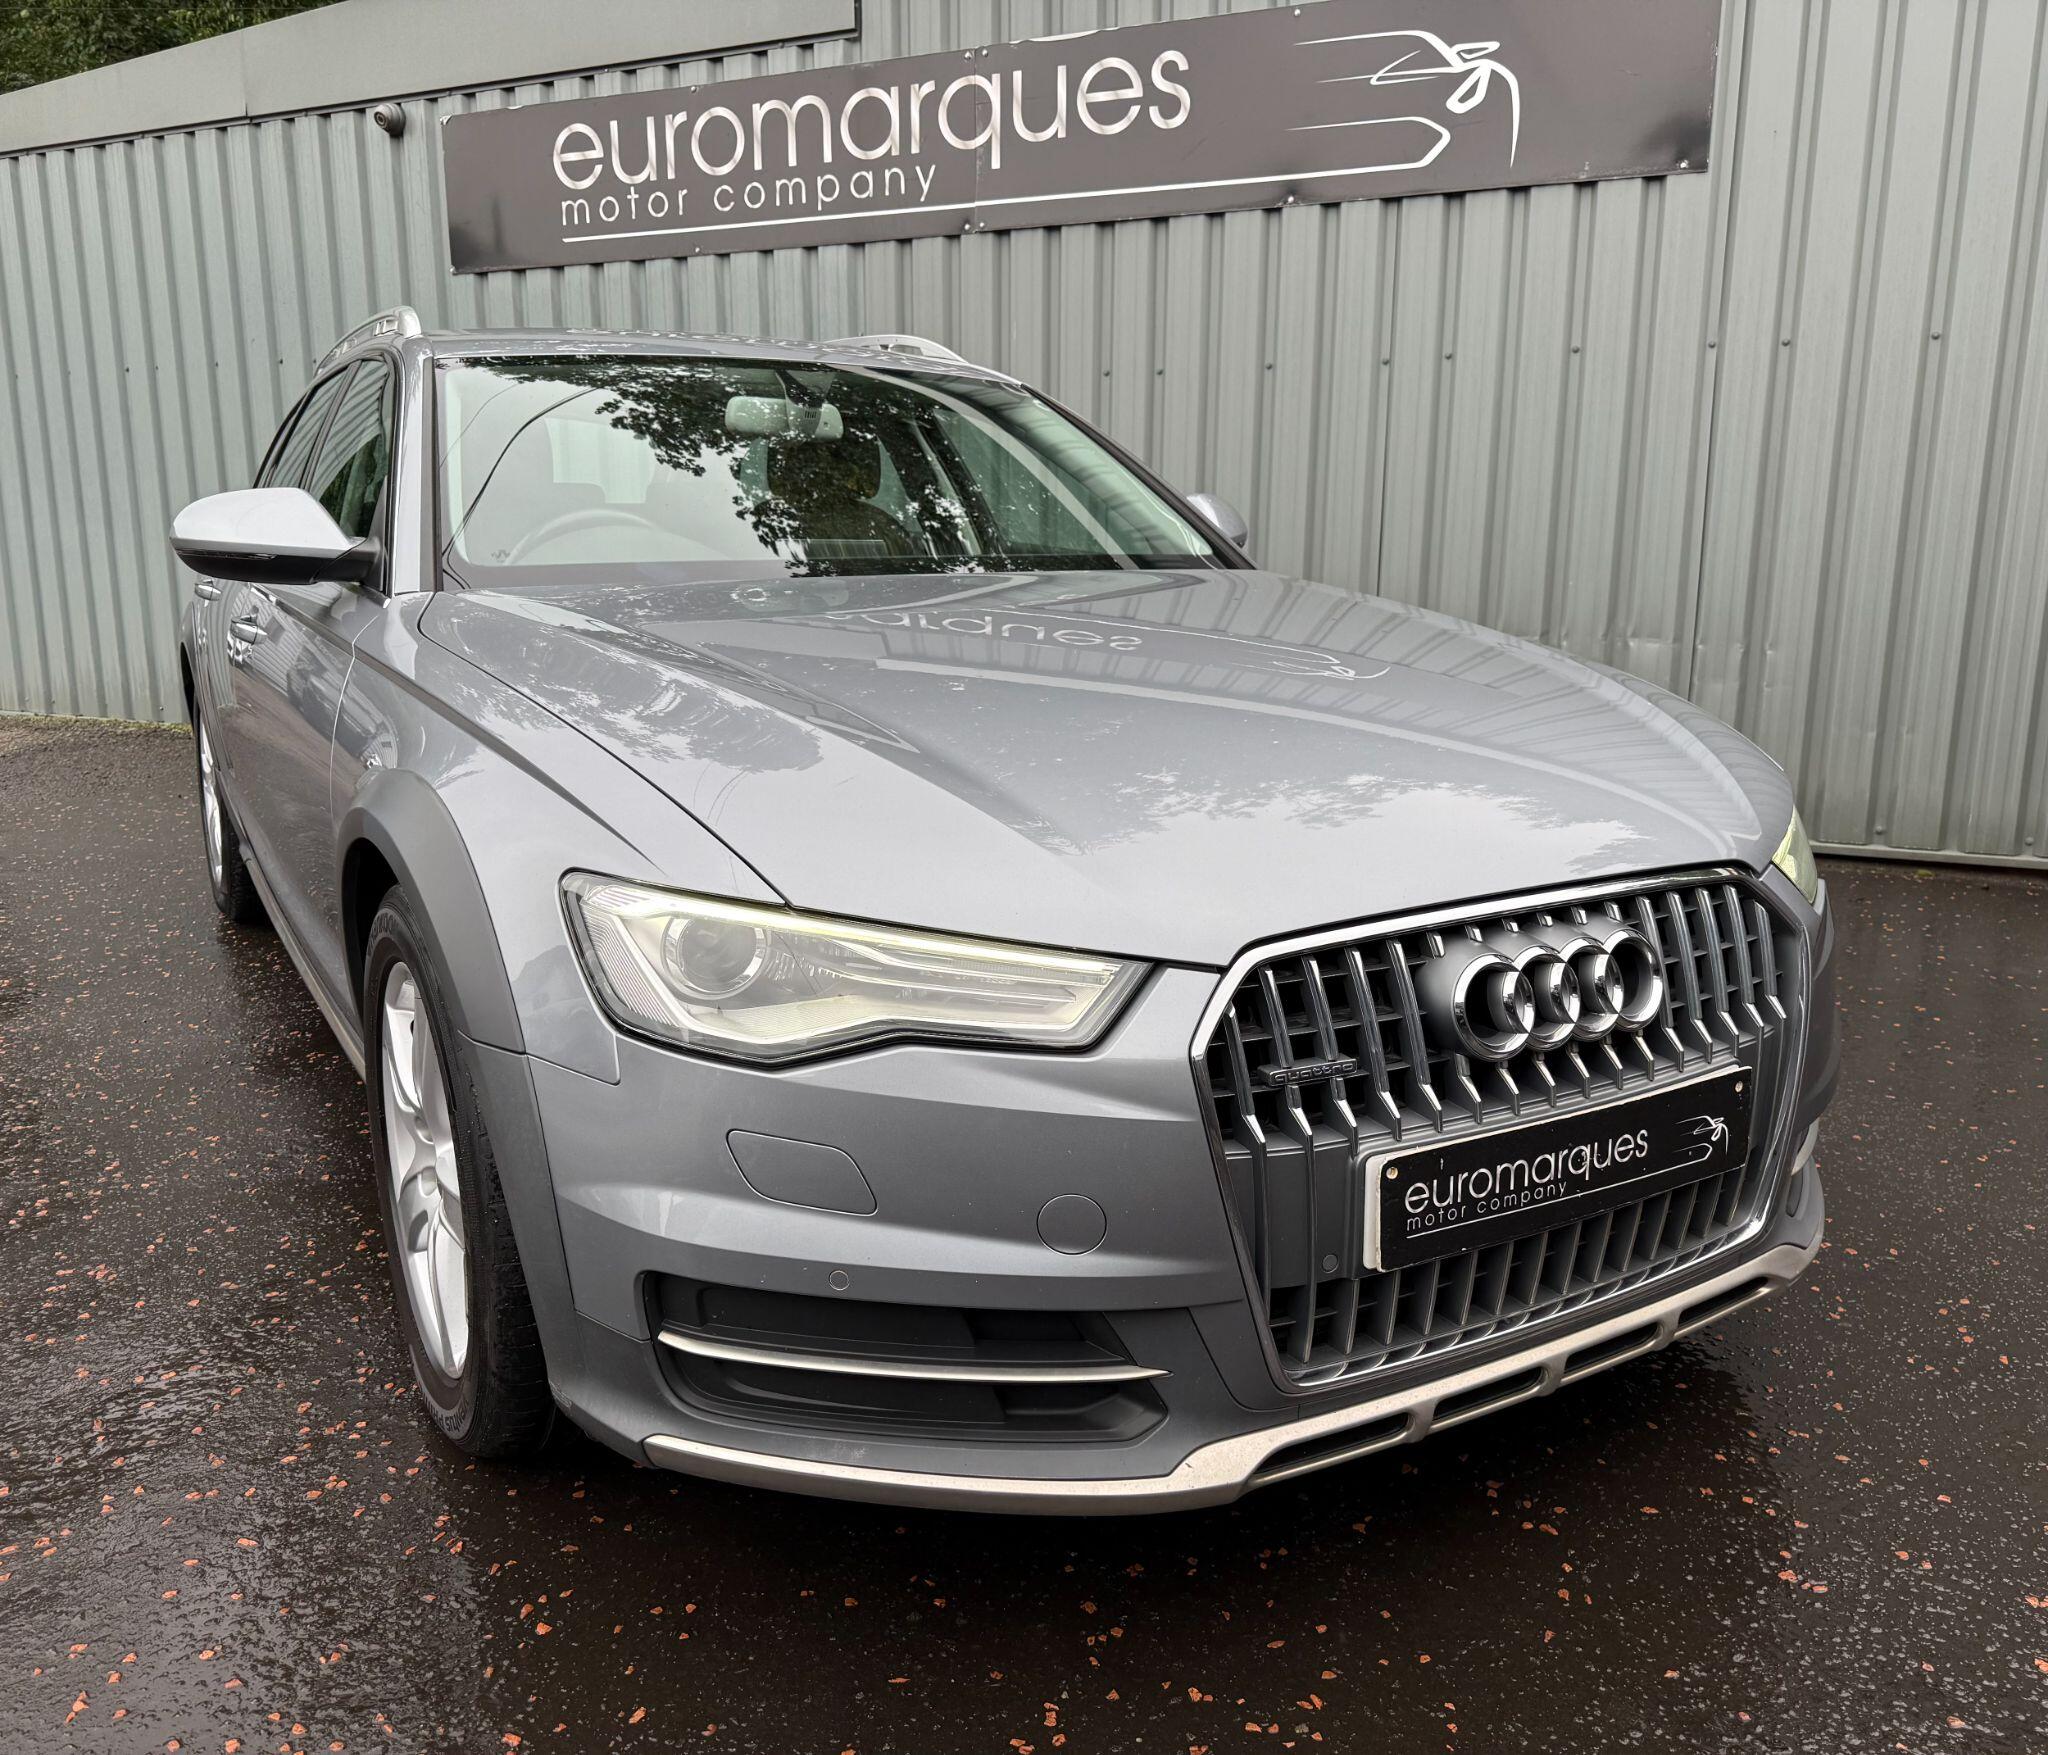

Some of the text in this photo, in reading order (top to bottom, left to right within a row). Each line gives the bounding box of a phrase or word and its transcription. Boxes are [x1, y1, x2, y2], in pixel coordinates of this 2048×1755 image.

[553, 50, 1191, 190] euromarques
[561, 165, 936, 226] motor company
[1274, 1063, 1353, 1083] quattro
[1405, 1129, 1648, 1214] euromarques
[1407, 1183, 1567, 1231] motor company
